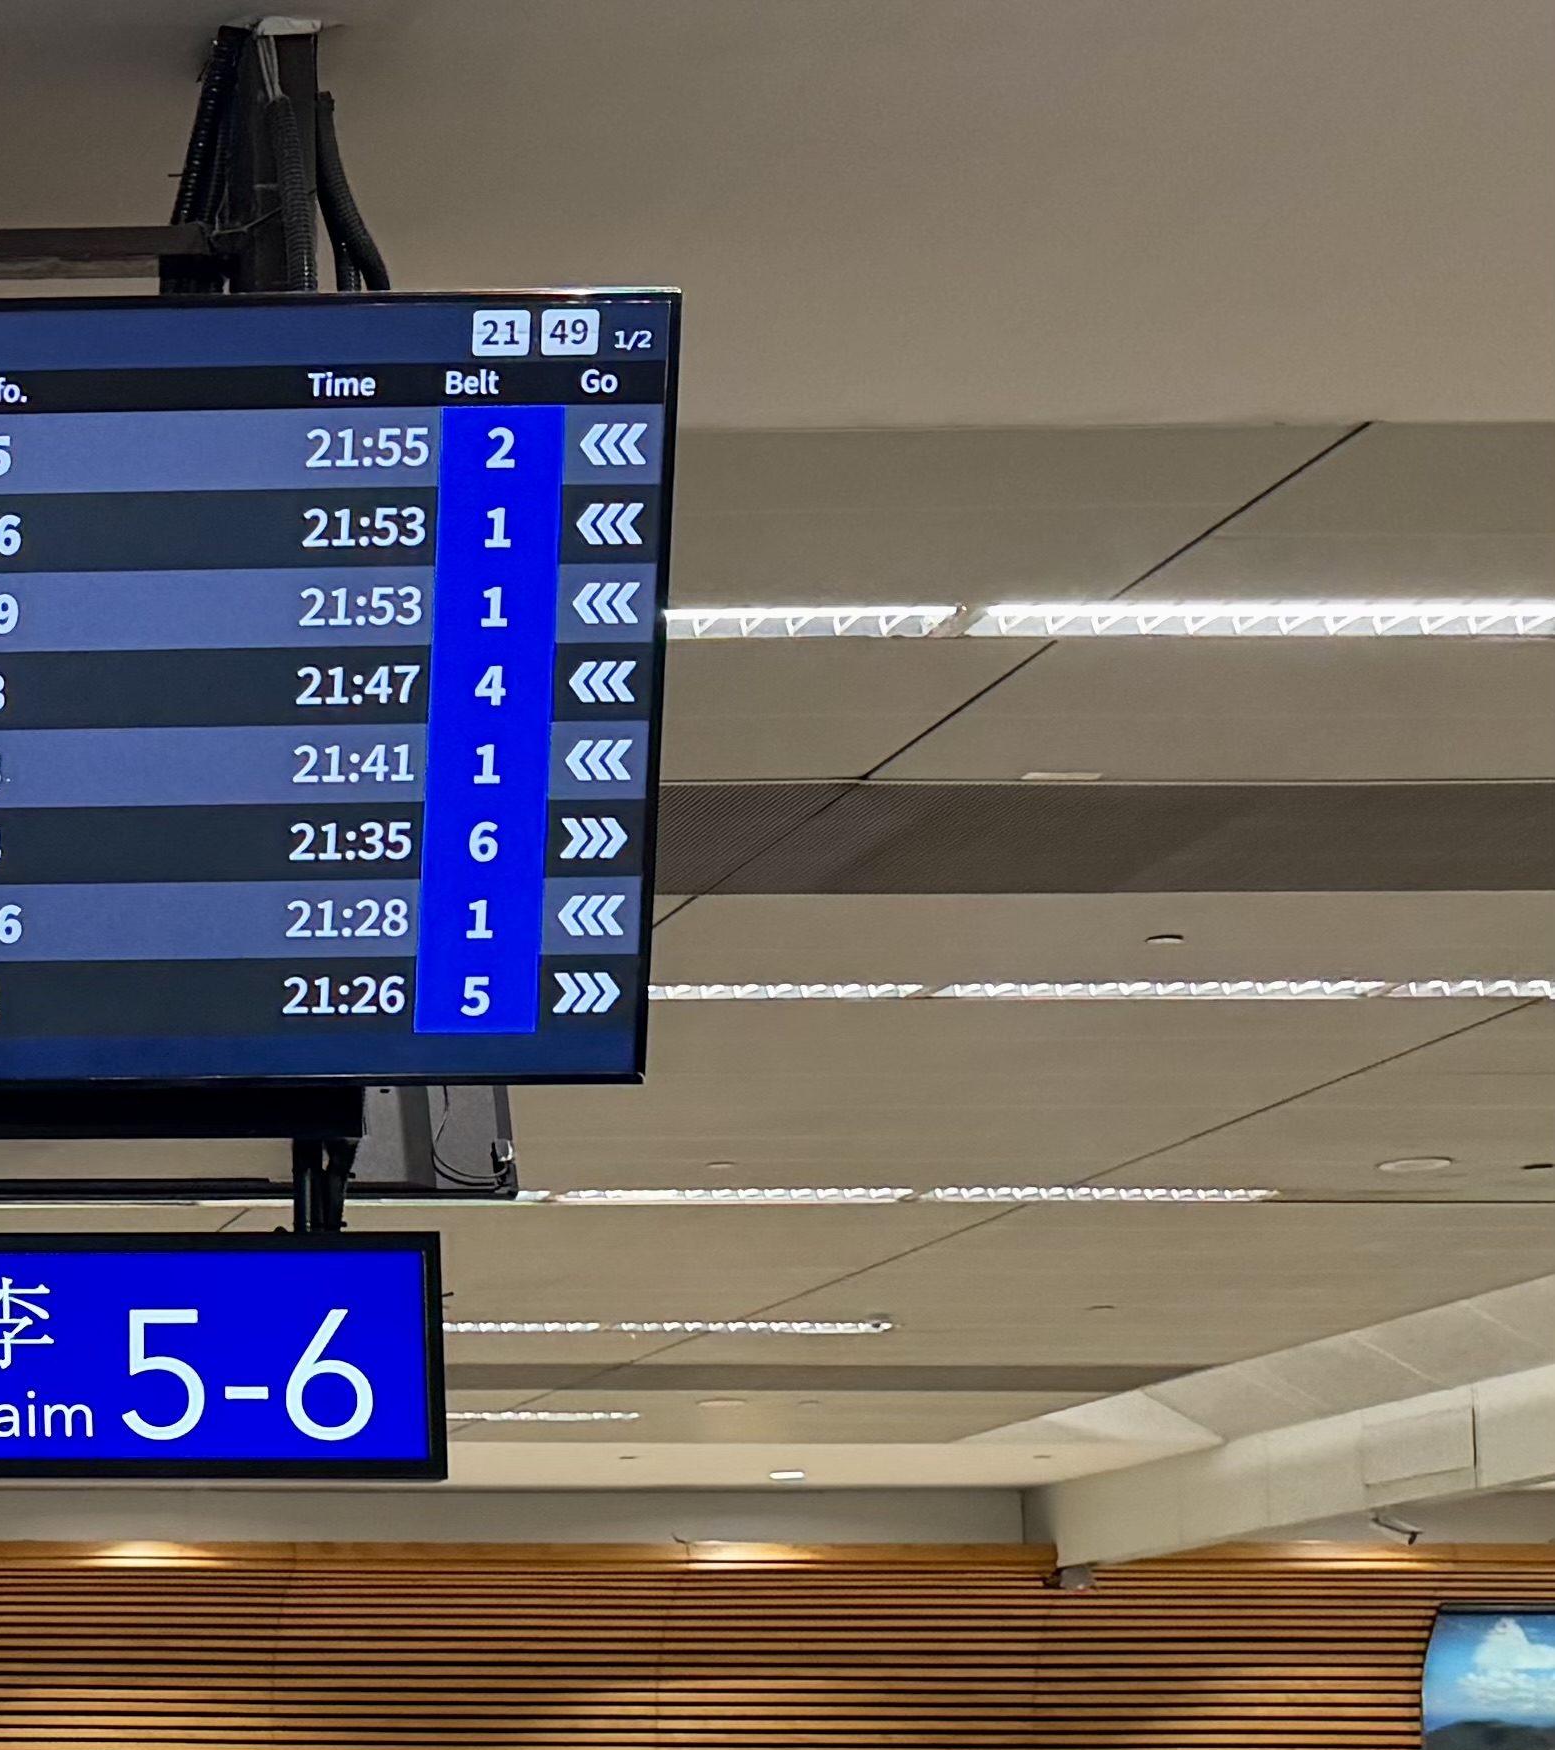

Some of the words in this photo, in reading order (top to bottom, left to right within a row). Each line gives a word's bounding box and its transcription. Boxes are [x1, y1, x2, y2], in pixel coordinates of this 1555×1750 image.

[614, 330, 652, 351] 1/2
[307, 371, 376, 397] Time
[445, 368, 500, 395] Belt
[580, 368, 618, 394] Go
[121, 1308, 374, 1441] 5-6
